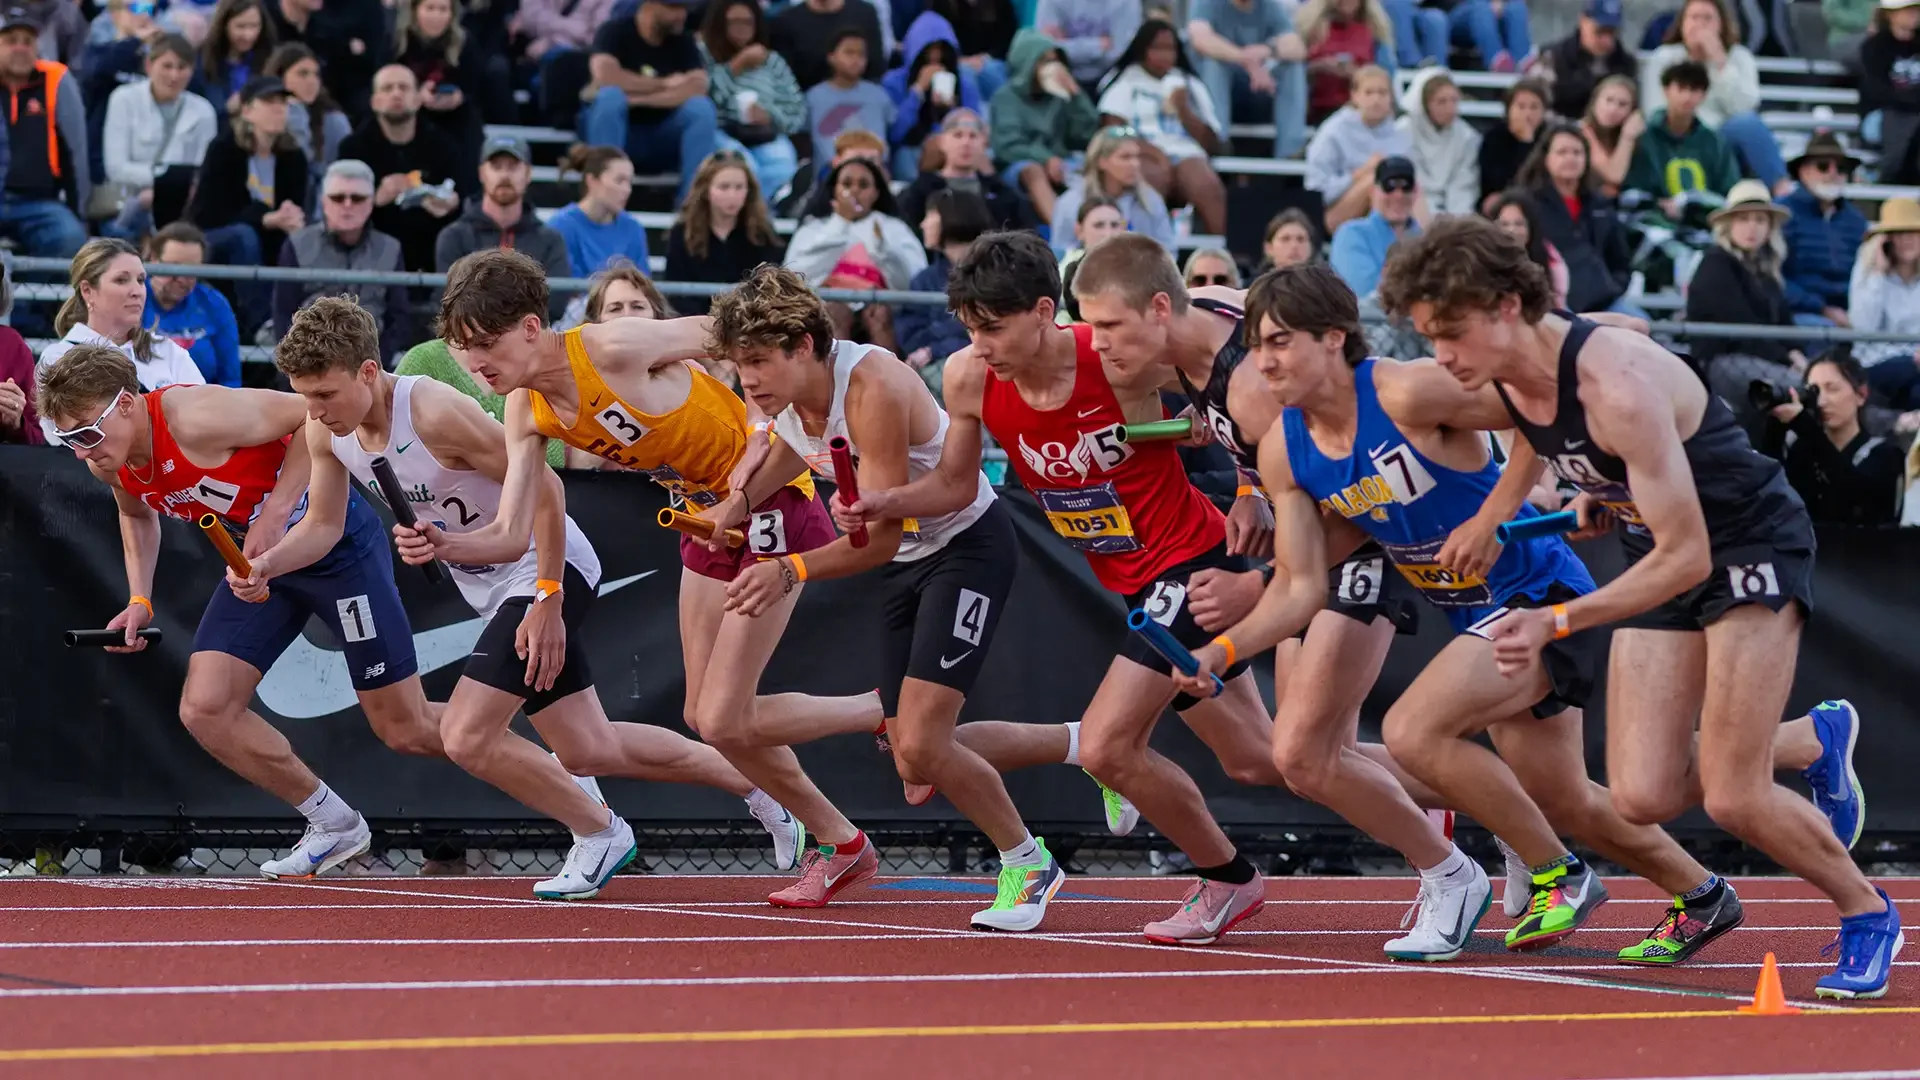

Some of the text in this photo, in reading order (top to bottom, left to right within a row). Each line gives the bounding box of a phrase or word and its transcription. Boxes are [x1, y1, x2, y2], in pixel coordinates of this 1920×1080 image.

[603, 410, 642, 442] 3
[1094, 429, 1126, 467] 5
[199, 484, 235, 502] 1
[1383, 451, 1417, 497] 7
[442, 496, 480, 526] 2
[1061, 514, 1119, 533] 1051
[758, 513, 778, 552] 3
[1148, 580, 1179, 618] 5
[1349, 559, 1372, 602] 6
[346, 600, 365, 638] 1
[961, 597, 983, 641] 4
